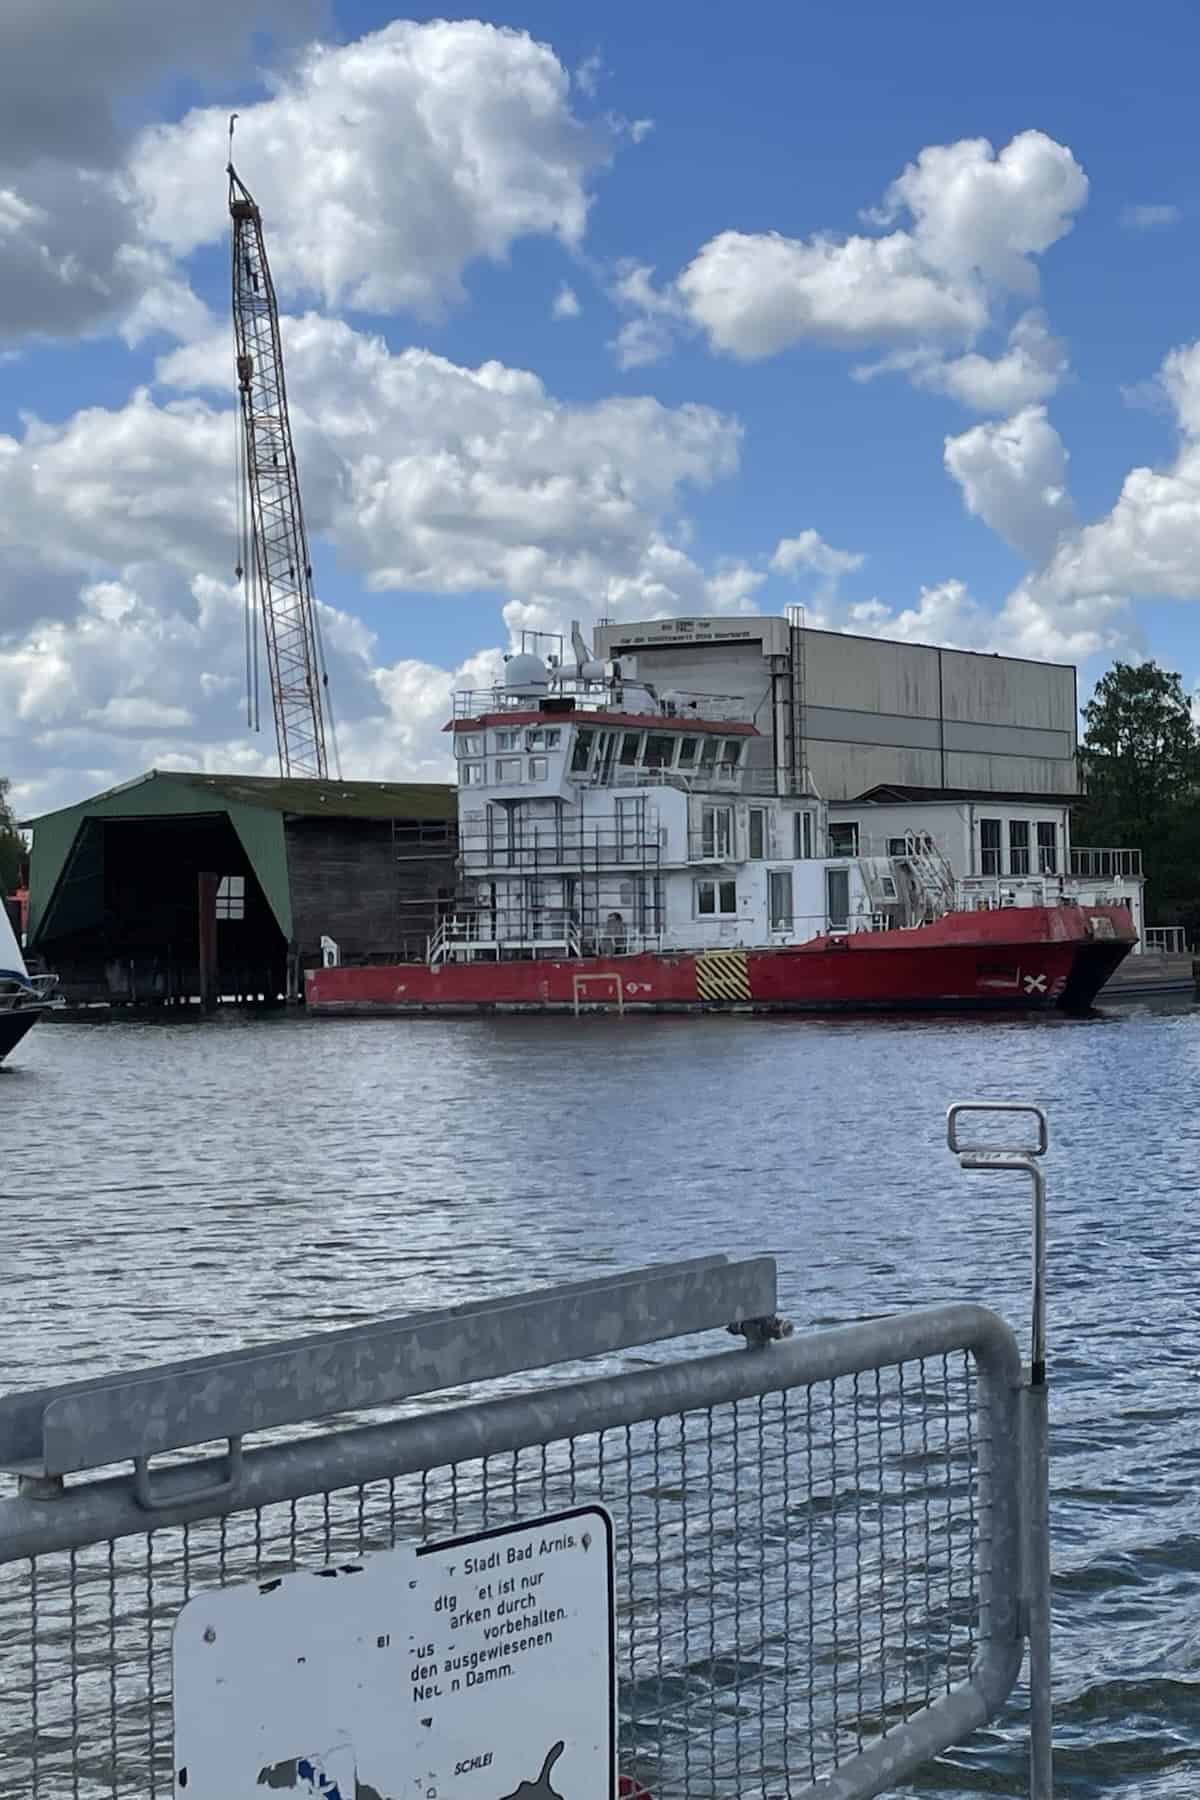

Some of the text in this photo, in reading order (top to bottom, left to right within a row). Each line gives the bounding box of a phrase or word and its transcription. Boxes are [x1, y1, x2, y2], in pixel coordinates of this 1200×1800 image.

[507, 1543, 532, 1564] Bad
[539, 1534, 577, 1556] Arnis.
[498, 1577, 515, 1595] ist
[521, 1572, 544, 1589] nur
[450, 1592, 536, 1629] arken durch
[483, 1608, 568, 1640] vorbehalten.
[411, 1632, 552, 1681] den ausgewiesenen
[466, 1664, 515, 1687] Damm.
[454, 1752, 493, 1776] SCHLEI
